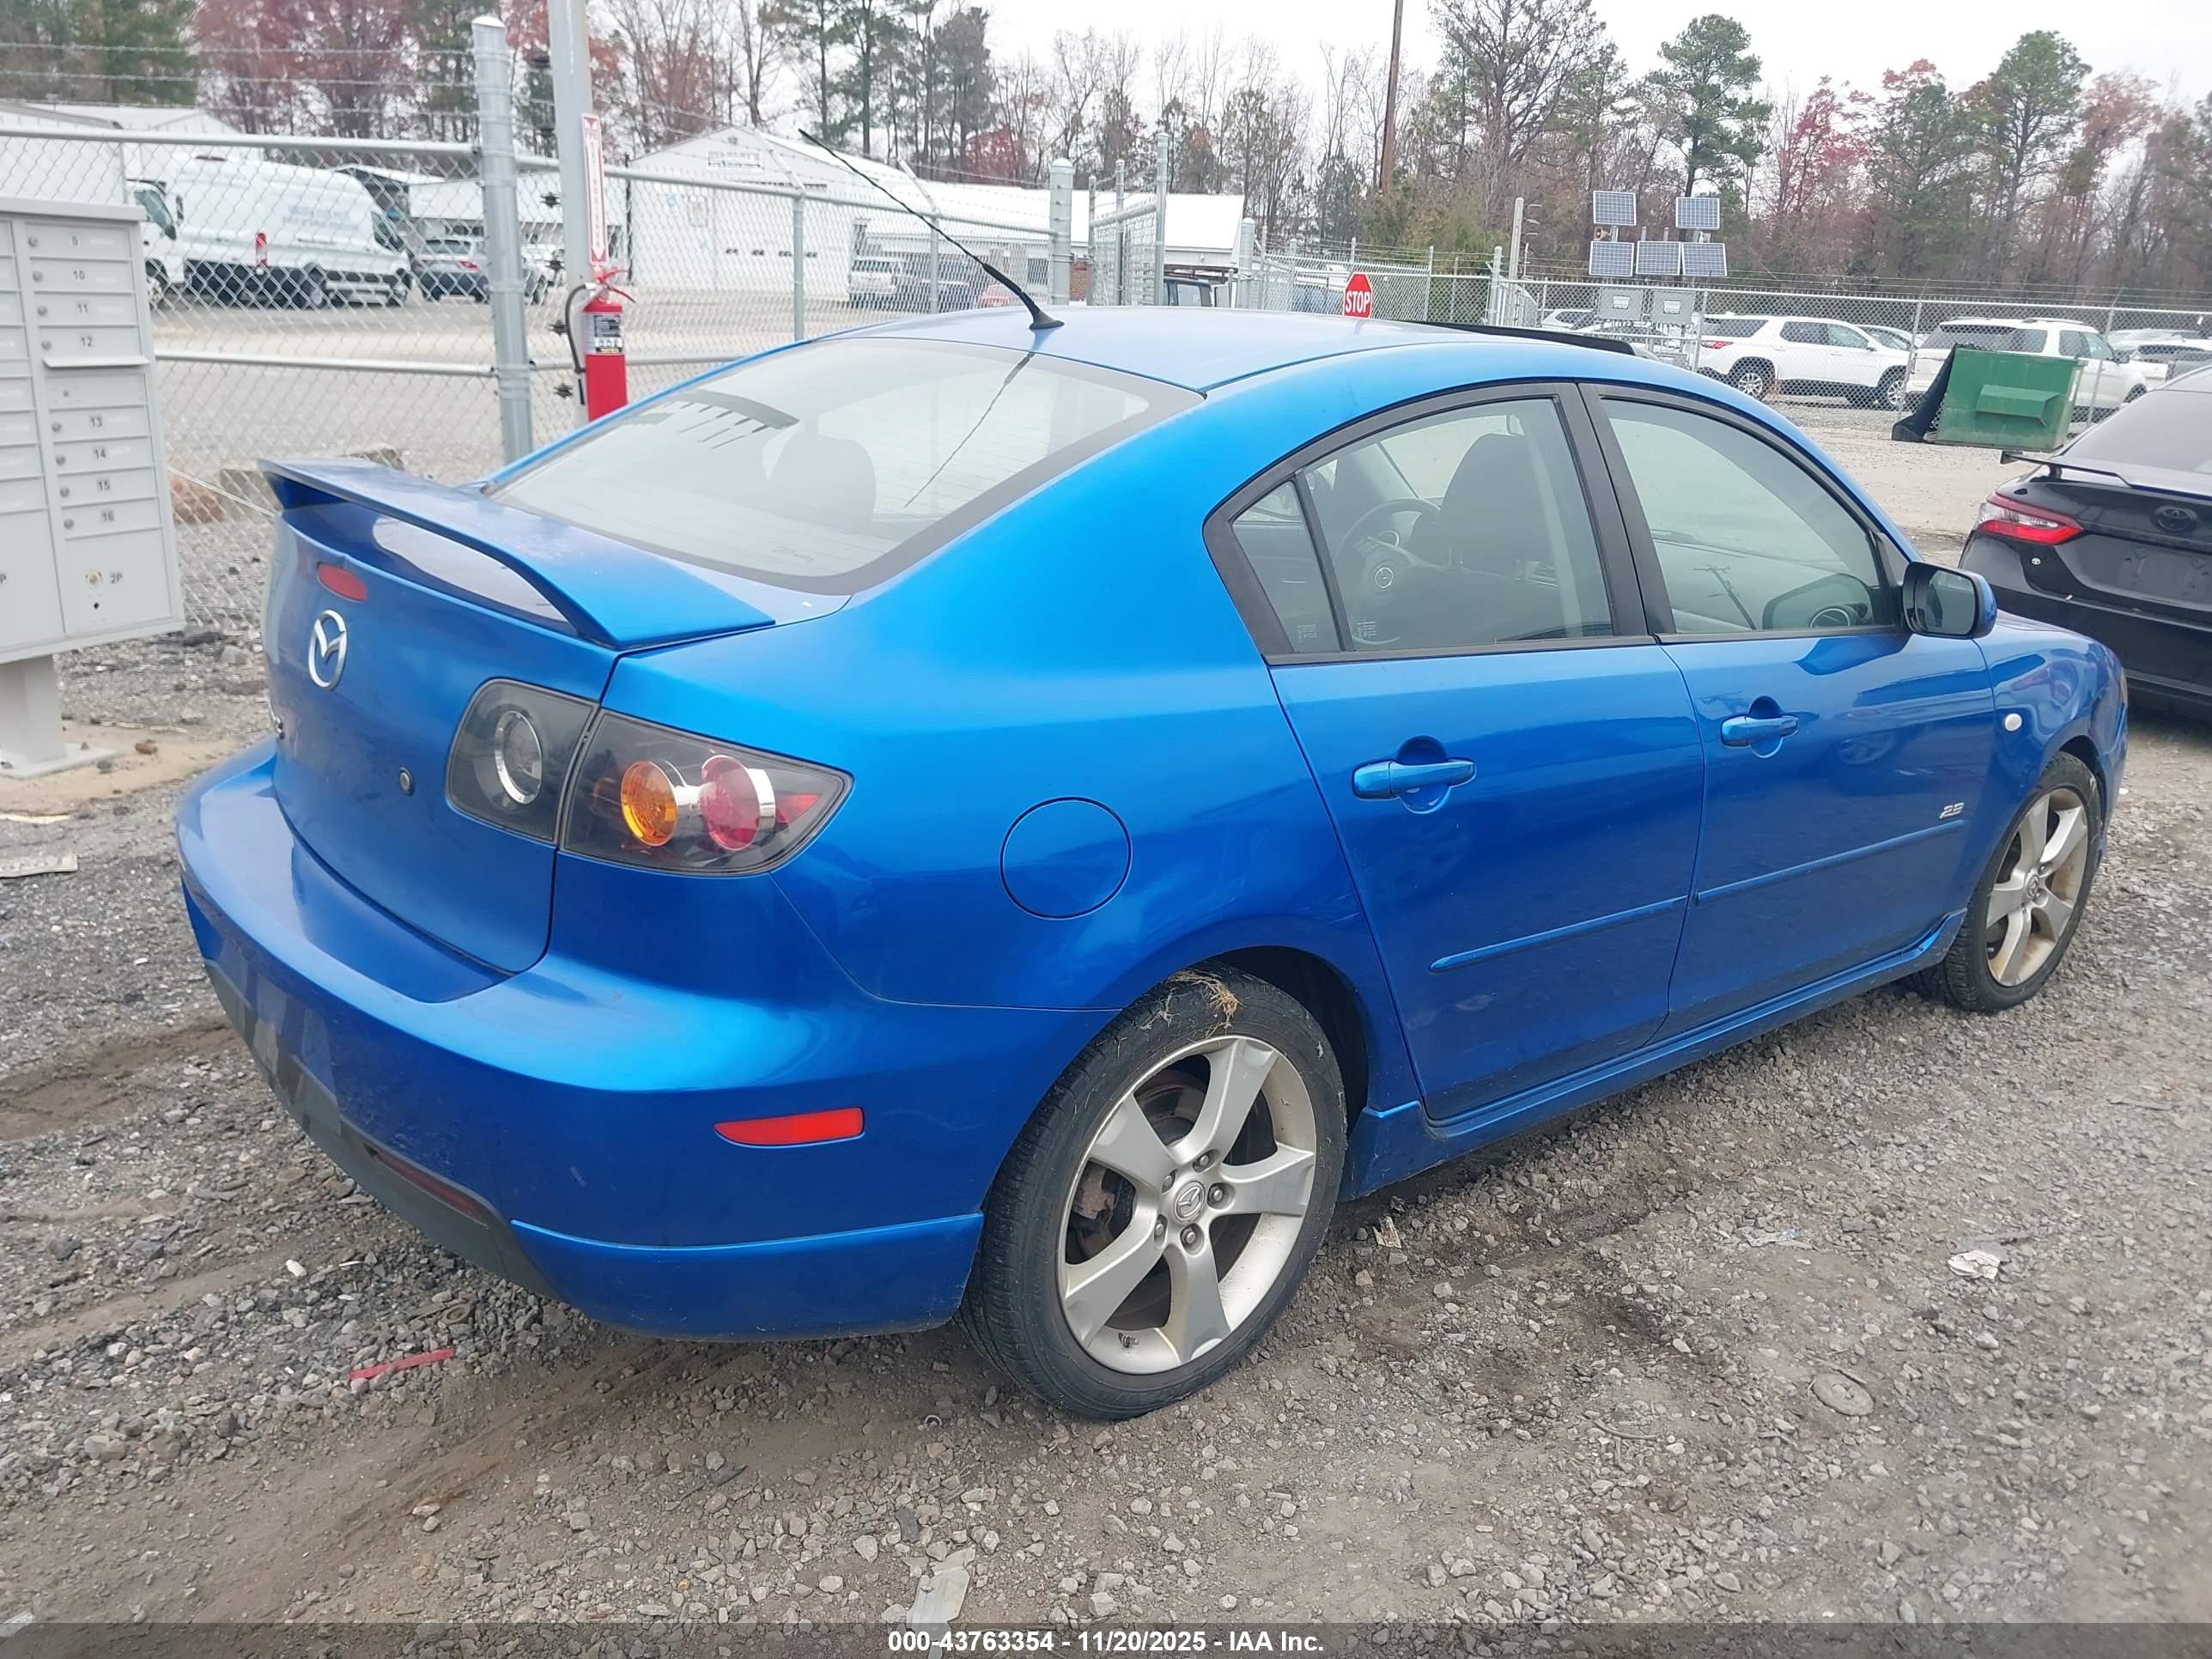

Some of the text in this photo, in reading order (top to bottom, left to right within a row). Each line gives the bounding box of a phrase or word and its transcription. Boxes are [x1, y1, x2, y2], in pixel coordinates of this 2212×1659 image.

[73, 270, 85, 281] 10
[1346, 290, 1370, 313] STOP
[77, 304, 88, 314] 11
[81, 336, 94, 347] 12
[90, 417, 103, 428] 13
[94, 448, 106, 459] 14
[98, 481, 110, 492] 15
[102, 511, 114, 523] 16
[110, 573, 123, 585] 2P
